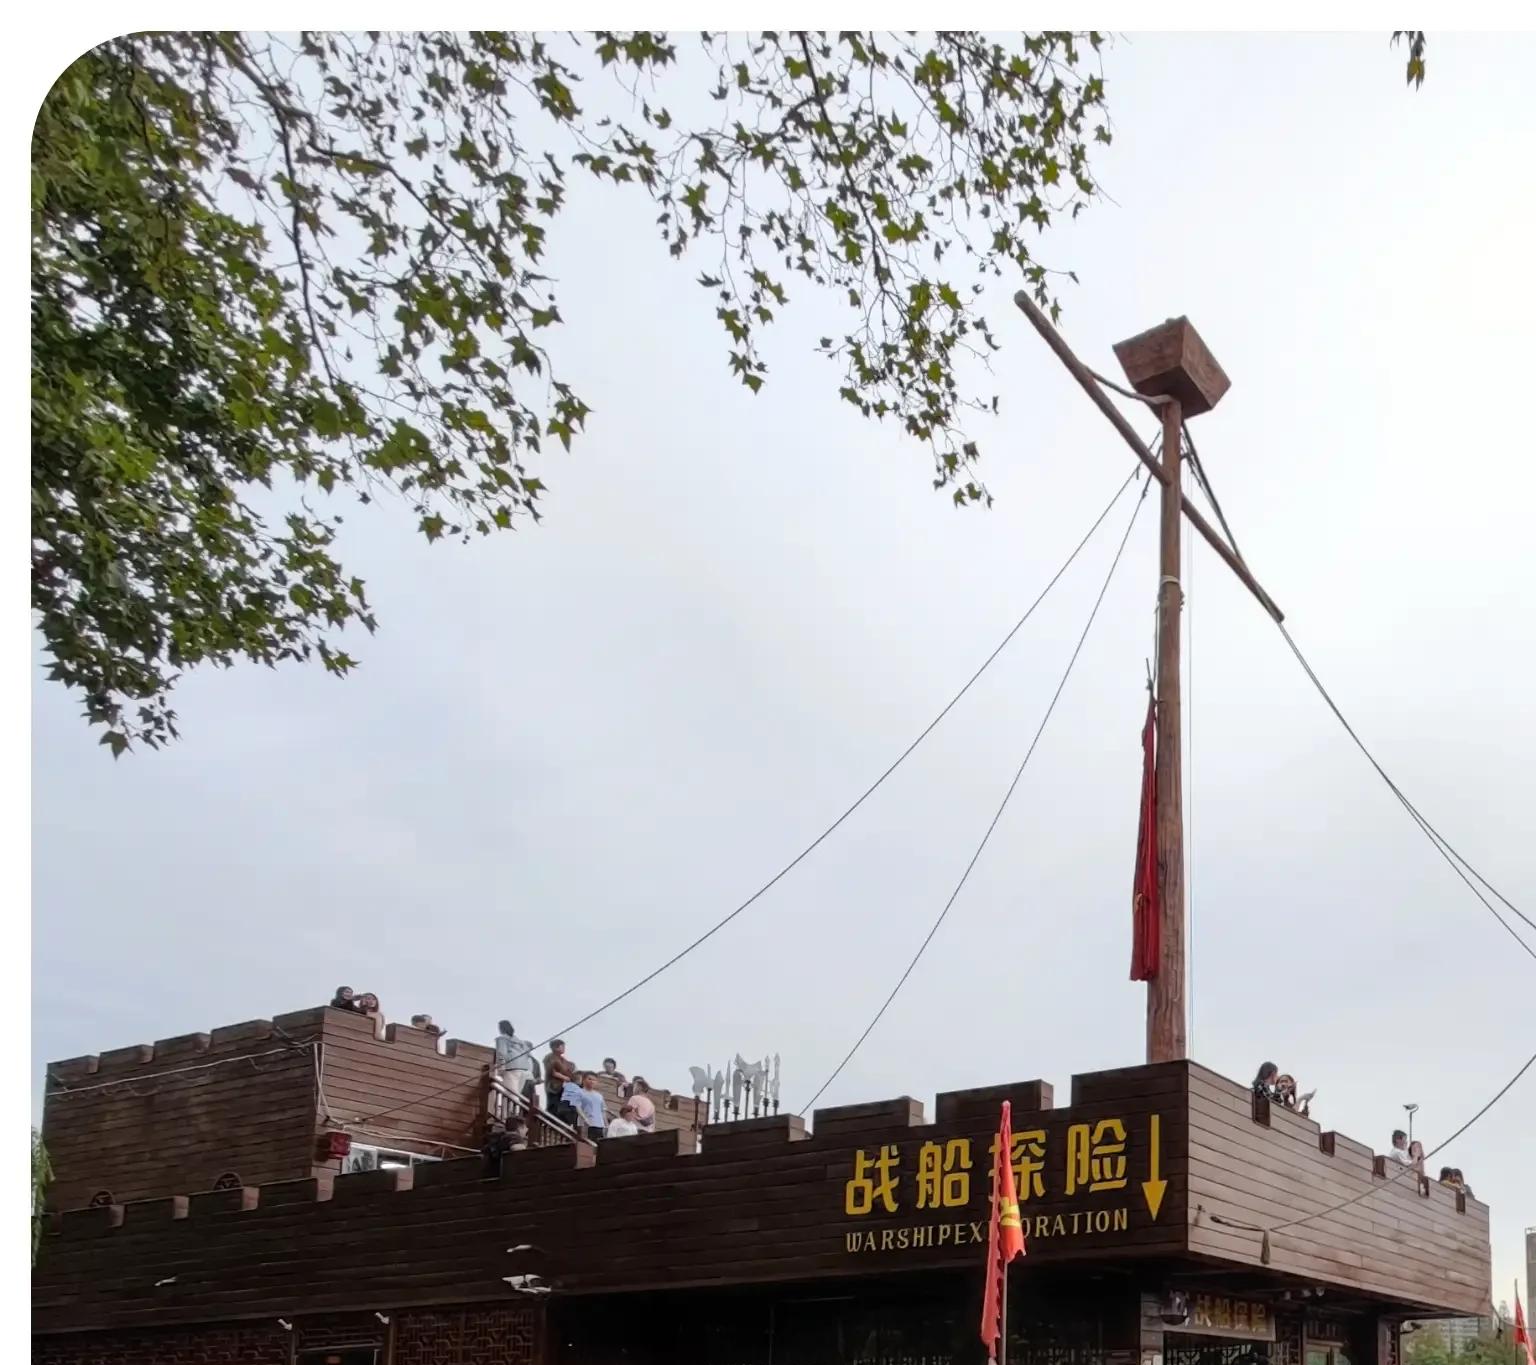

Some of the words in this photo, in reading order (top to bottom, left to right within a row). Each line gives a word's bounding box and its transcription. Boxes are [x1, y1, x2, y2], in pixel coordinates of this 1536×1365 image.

[845, 1118, 1128, 1216] 战船探险
[845, 1207, 1128, 1253] WARSHIPEXORATION
